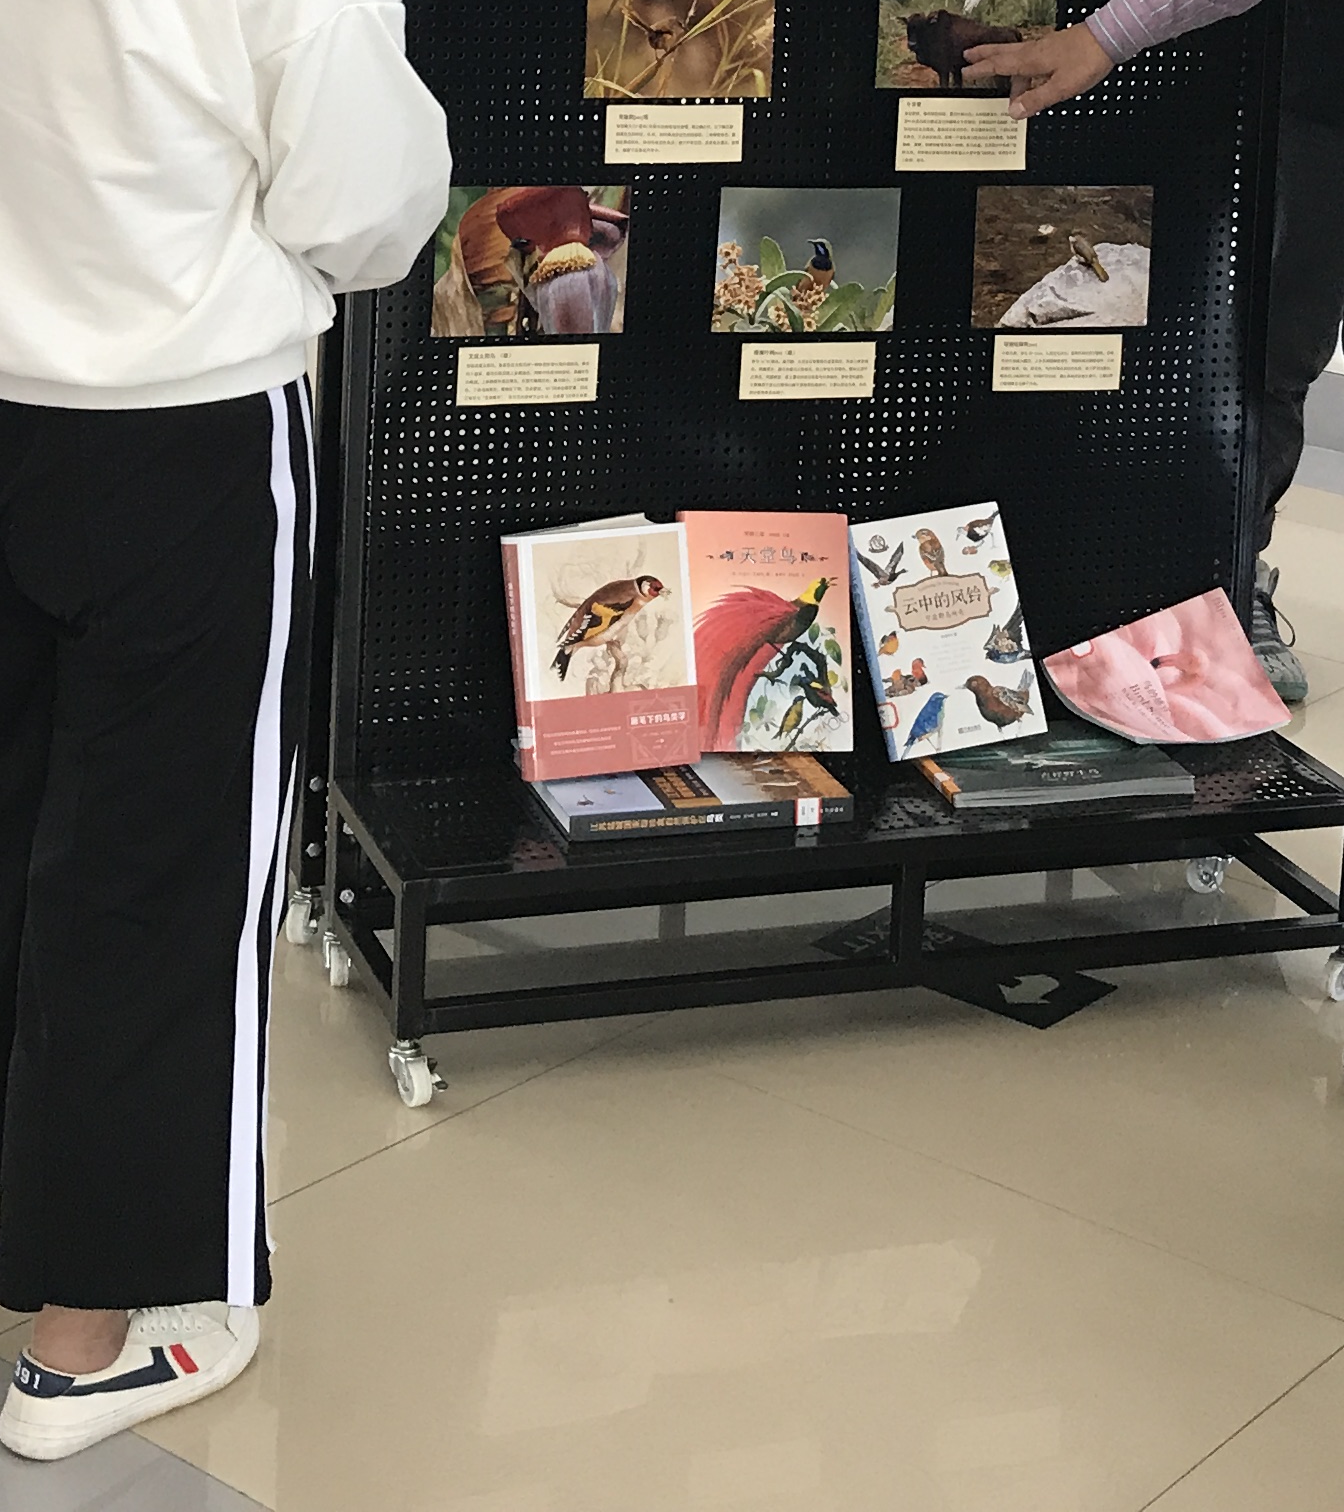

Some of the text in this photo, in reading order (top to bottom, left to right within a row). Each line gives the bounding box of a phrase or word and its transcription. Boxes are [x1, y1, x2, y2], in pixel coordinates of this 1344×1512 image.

[740, 546, 797, 565] 天堂鸟
[902, 585, 982, 616] 云中的风铃
